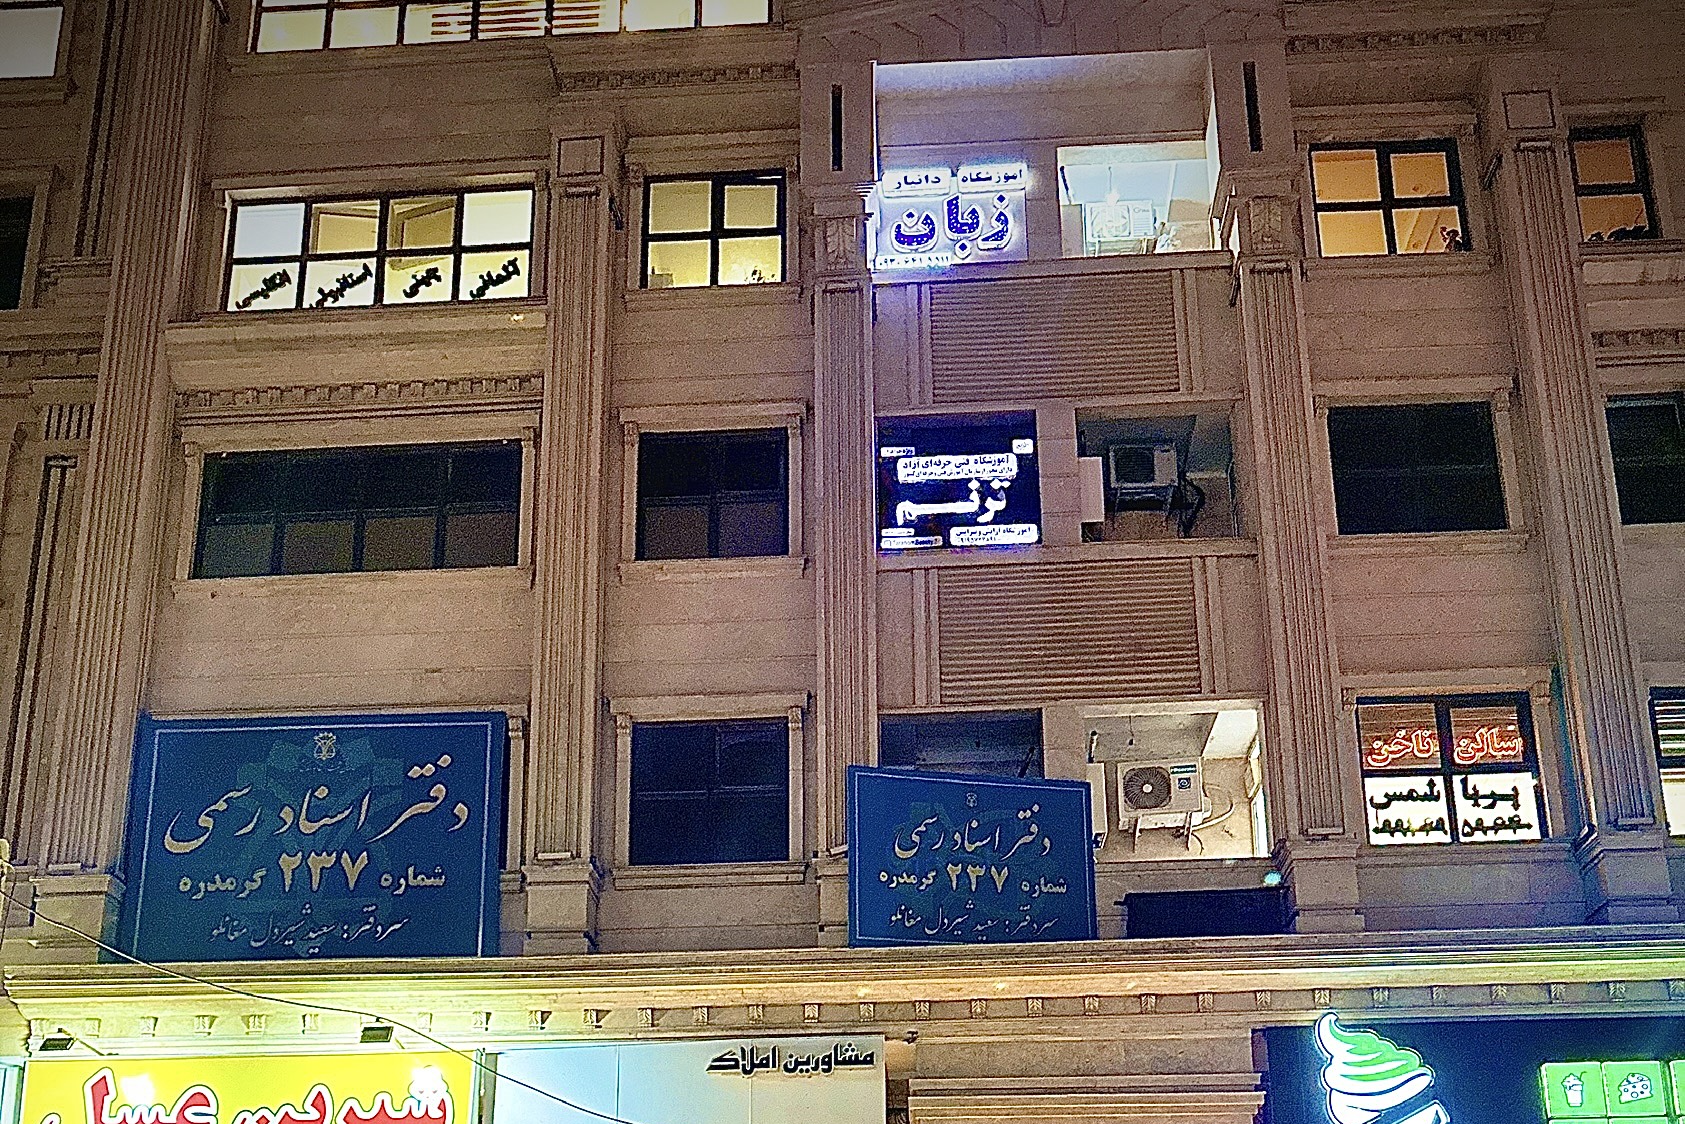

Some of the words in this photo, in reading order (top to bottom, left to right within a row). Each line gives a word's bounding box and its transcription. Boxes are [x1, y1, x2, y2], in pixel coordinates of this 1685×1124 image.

[894, 174, 941, 190] دانیار
[960, 169, 1023, 184] آموزشگاه
[893, 193, 1010, 252] زبان
[973, 455, 1009, 467] آموزشگاه
[896, 478, 1011, 526] ترنم
[1367, 728, 1434, 767] ناخن
[367, 754, 470, 844] دفتر
[1369, 778, 1441, 810] شمس
[163, 783, 263, 854] رسمی
[273, 786, 372, 836] اسناد
[894, 814, 945, 859] رسمی
[951, 819, 1000, 852] اسناد
[1000, 803, 1051, 862] دفتر
[179, 867, 267, 900] گرمدره
[278, 850, 369, 893] ۲۳۷
[380, 865, 446, 897] شماره
[879, 869, 937, 891] گرمدره
[946, 863, 1009, 894] ۲۳۷
[1020, 877, 1068, 898] شماره
[250, 903, 312, 947] شیردل
[924, 900, 976, 935] شیردل
[972, 917, 1000, 941] سعید
[302, 921, 338, 954] سعید
[706, 1044, 779, 1076] املاک
[783, 1042, 875, 1075] مشاورین
